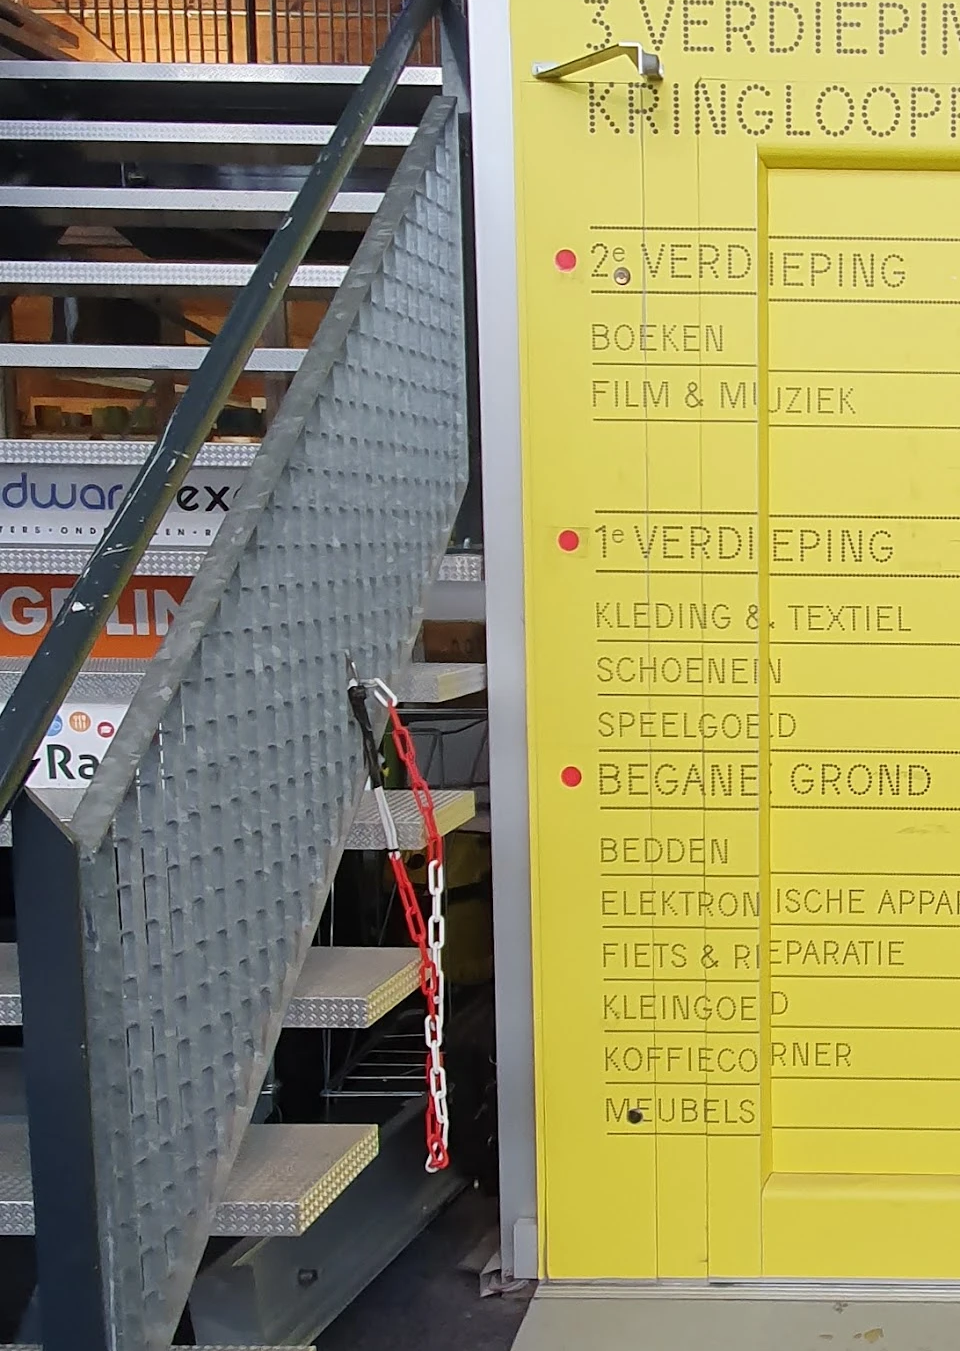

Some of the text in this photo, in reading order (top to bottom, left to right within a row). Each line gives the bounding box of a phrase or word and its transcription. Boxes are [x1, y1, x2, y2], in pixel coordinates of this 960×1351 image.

[640, 243, 907, 289] VERDIEPING
[591, 323, 724, 353] BOEKEN
[591, 380, 857, 415] FILM & MUZIEK
[176, 483, 241, 512] ex
[634, 525, 895, 564] VERDIEPING
[595, 602, 912, 633] KLEDING & TEXTIEL
[596, 656, 783, 685] SCHOENEN
[597, 711, 797, 740] SPEELGOED
[598, 763, 932, 797] BEGANE GROND
[600, 837, 729, 865] BEDDEN
[601, 887, 866, 918] ELEKTRONISCHE
[602, 939, 906, 970] FIETS & REPARATIE
[603, 990, 789, 1021] KLEINGOED
[604, 1041, 853, 1073] KOFFIECORNER
[605, 1097, 756, 1125] MEUBELS
